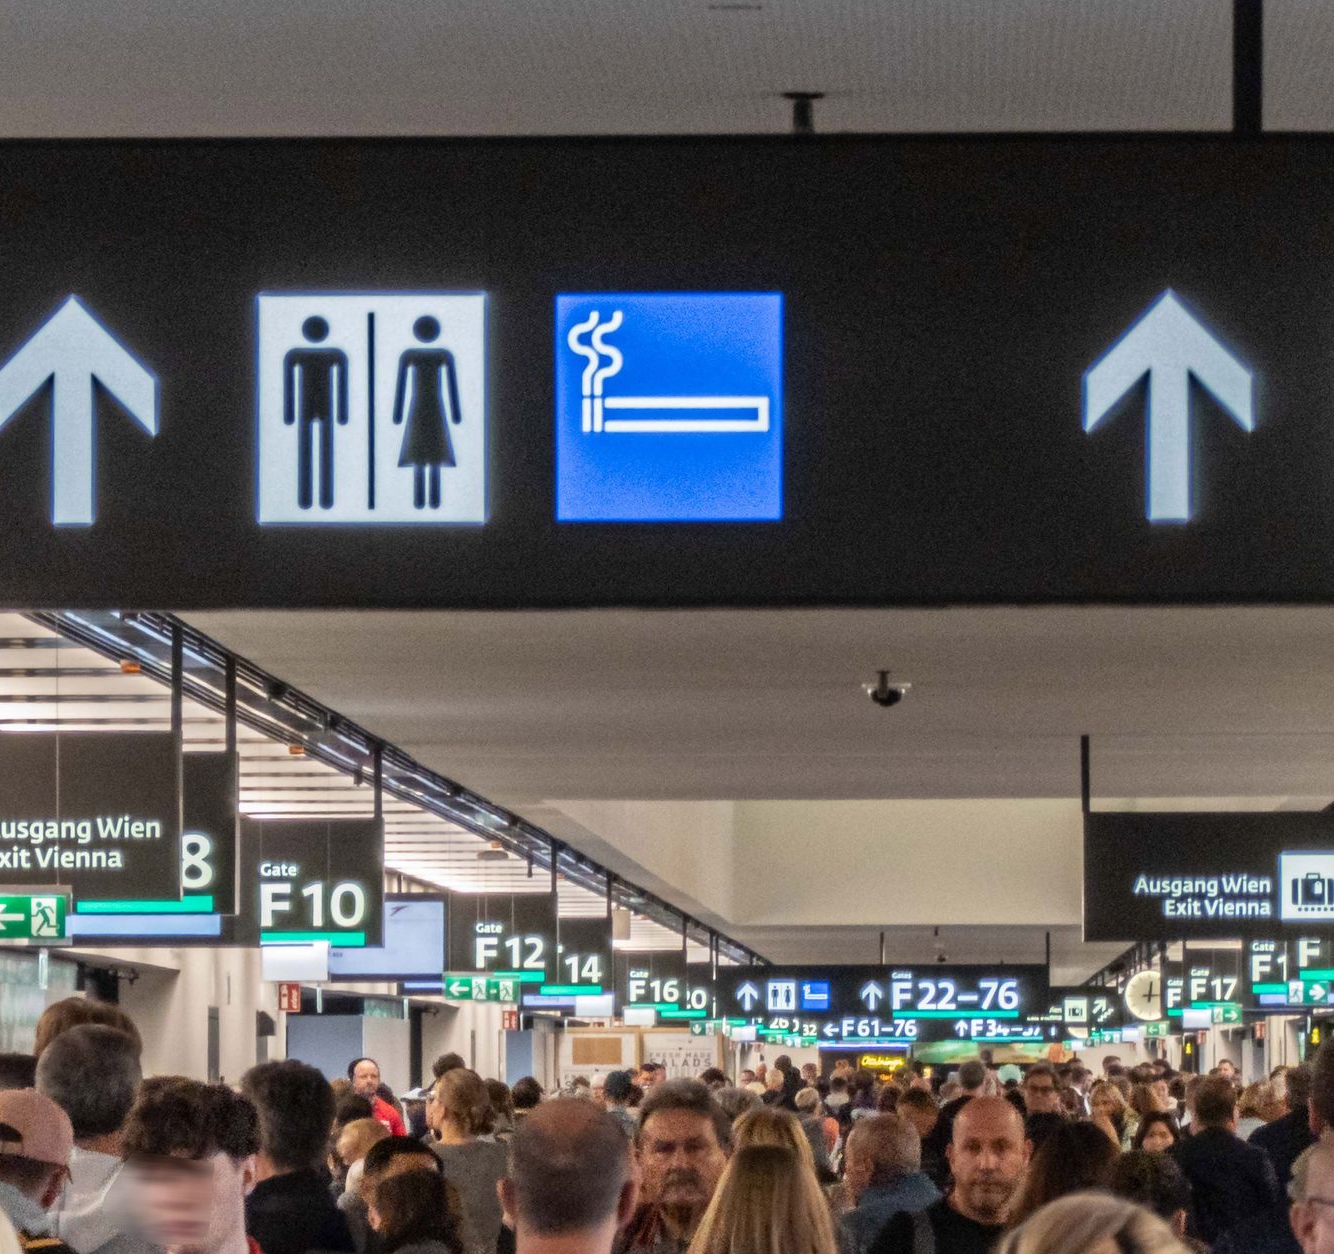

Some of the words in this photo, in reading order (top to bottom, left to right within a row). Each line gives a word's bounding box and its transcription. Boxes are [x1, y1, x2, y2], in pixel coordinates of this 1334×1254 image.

[96, 815, 161, 839] Wien
[34, 846, 123, 869] Vienna
[181, 833, 214, 889] 8
[260, 862, 298, 877] Gate
[1134, 876, 1219, 897] Ausgang
[1221, 874, 1272, 894] Wien
[260, 883, 292, 928] F
[301, 882, 366, 928] 10
[1164, 898, 1201, 916] Exit
[1205, 898, 1272, 916] Vienna
[475, 922, 502, 934] Gate
[475, 937, 499, 969] F
[504, 936, 546, 969] 12
[1251, 942, 1275, 952] Gate
[564, 954, 603, 984] 14
[629, 971, 649, 979] Gate
[1190, 969, 1210, 977] Gate
[1251, 954, 1272, 982] F
[629, 980, 646, 1002] F
[649, 979, 680, 1003] 16
[892, 981, 913, 1010] F
[1167, 987, 1182, 1008] F
[1190, 977, 1207, 1001] F
[1210, 977, 1238, 1001] 17
[841, 1019, 855, 1037] F
[970, 1018, 984, 1037] F
